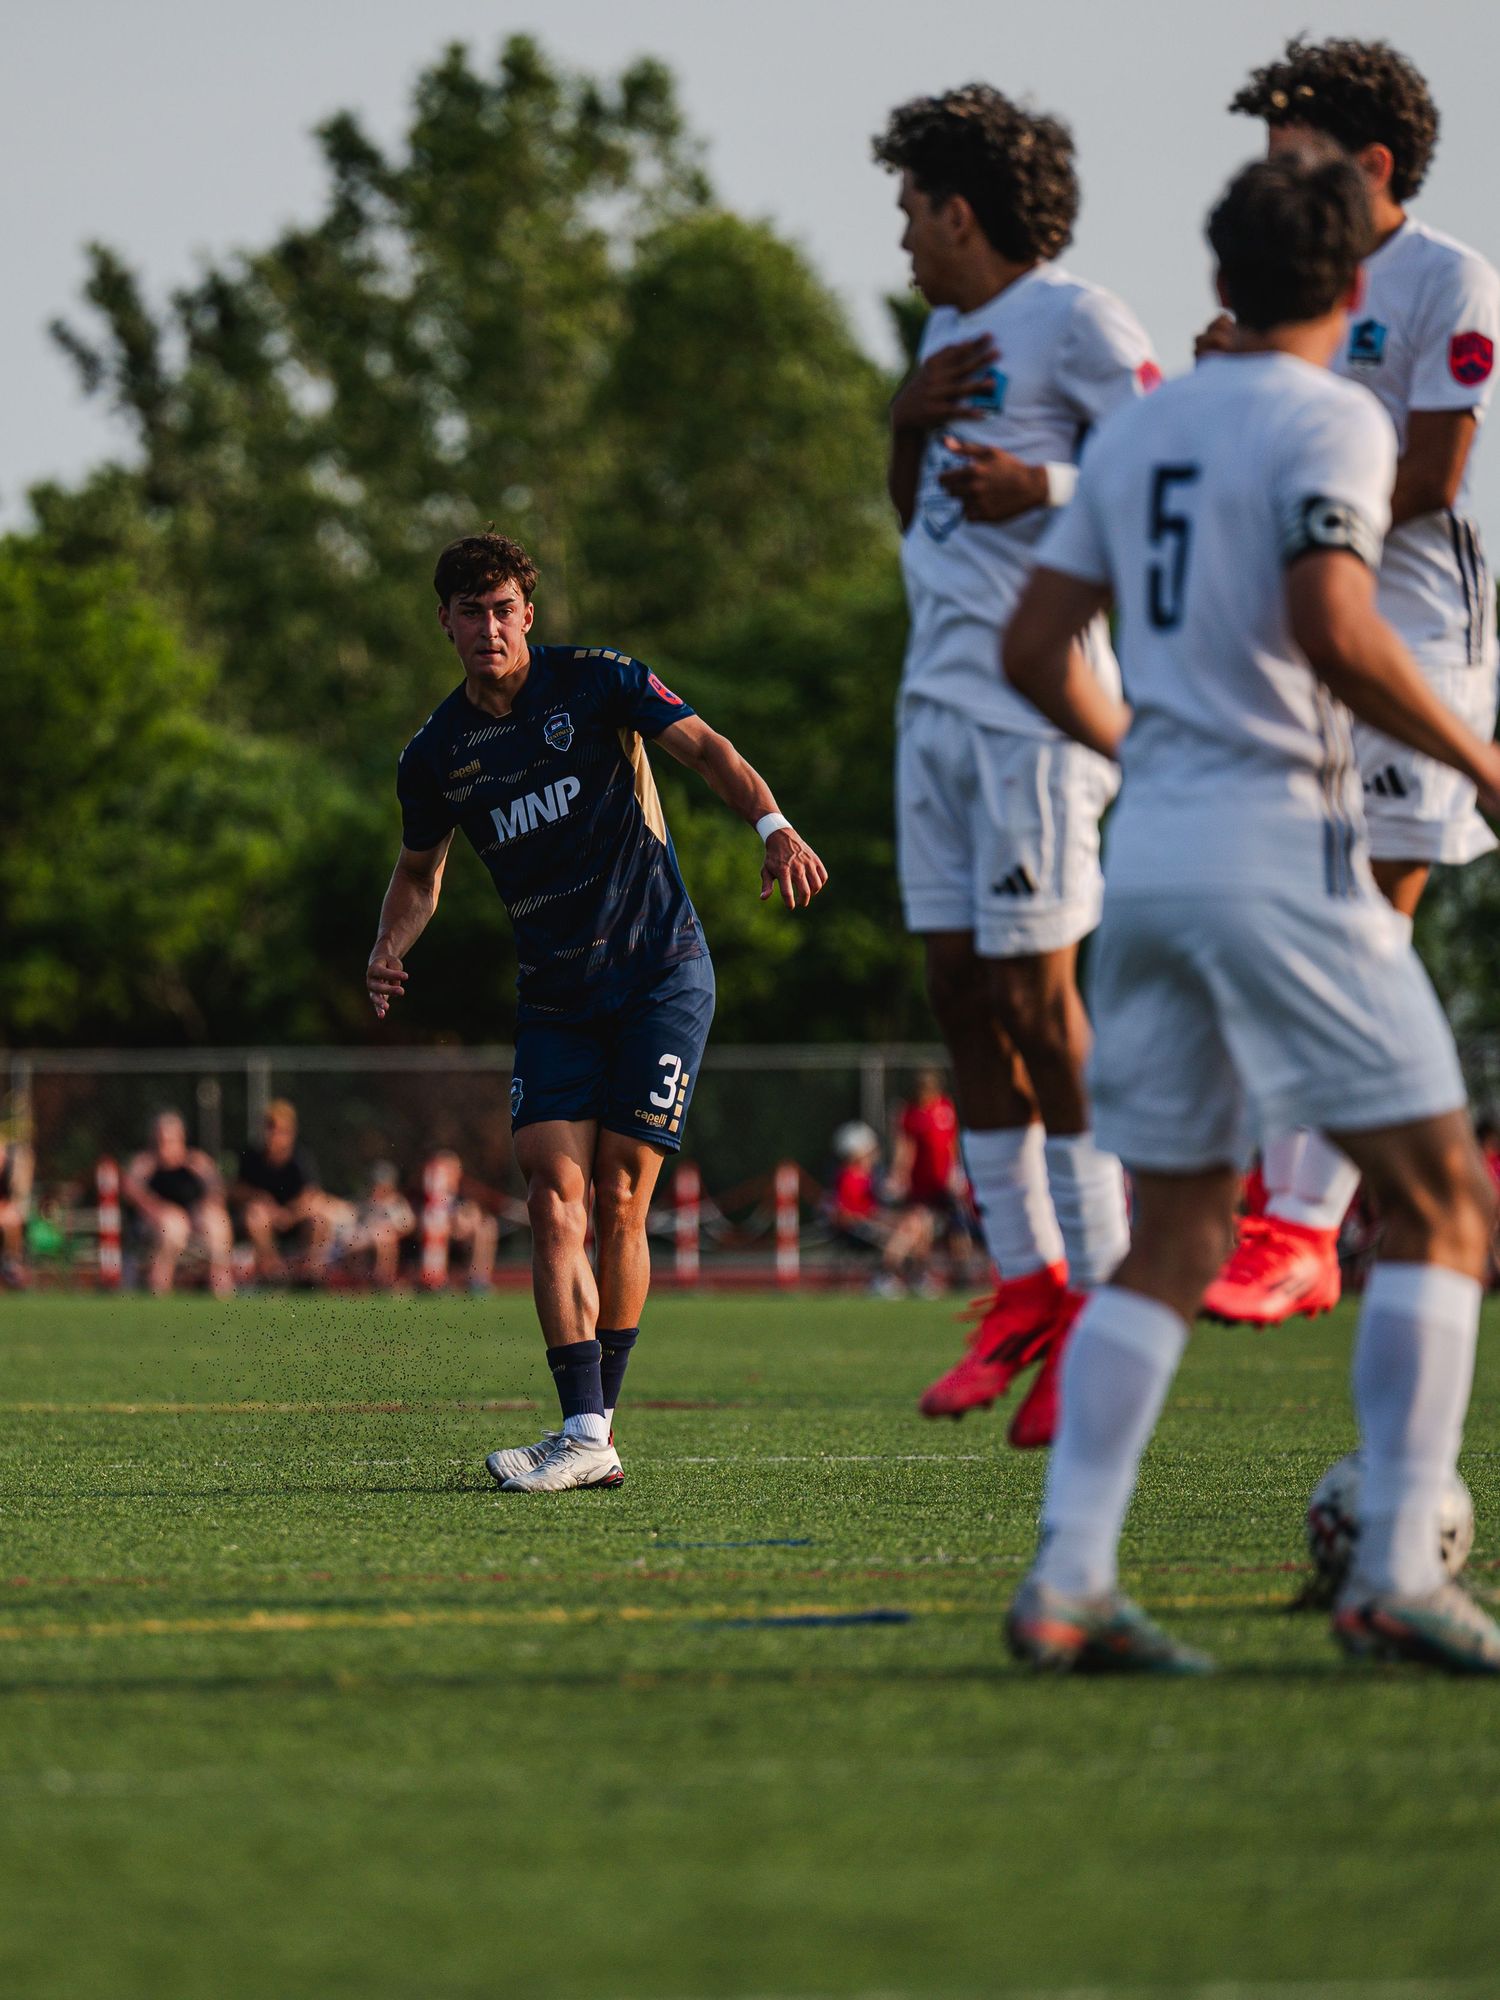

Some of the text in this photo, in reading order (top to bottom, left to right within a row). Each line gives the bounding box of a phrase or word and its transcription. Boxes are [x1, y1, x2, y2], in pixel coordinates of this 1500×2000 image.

[1146, 462, 1200, 632] 5
[489, 775, 581, 843] MNP
[650, 1053, 682, 1109] 3
[634, 1109, 668, 1124] capelli
